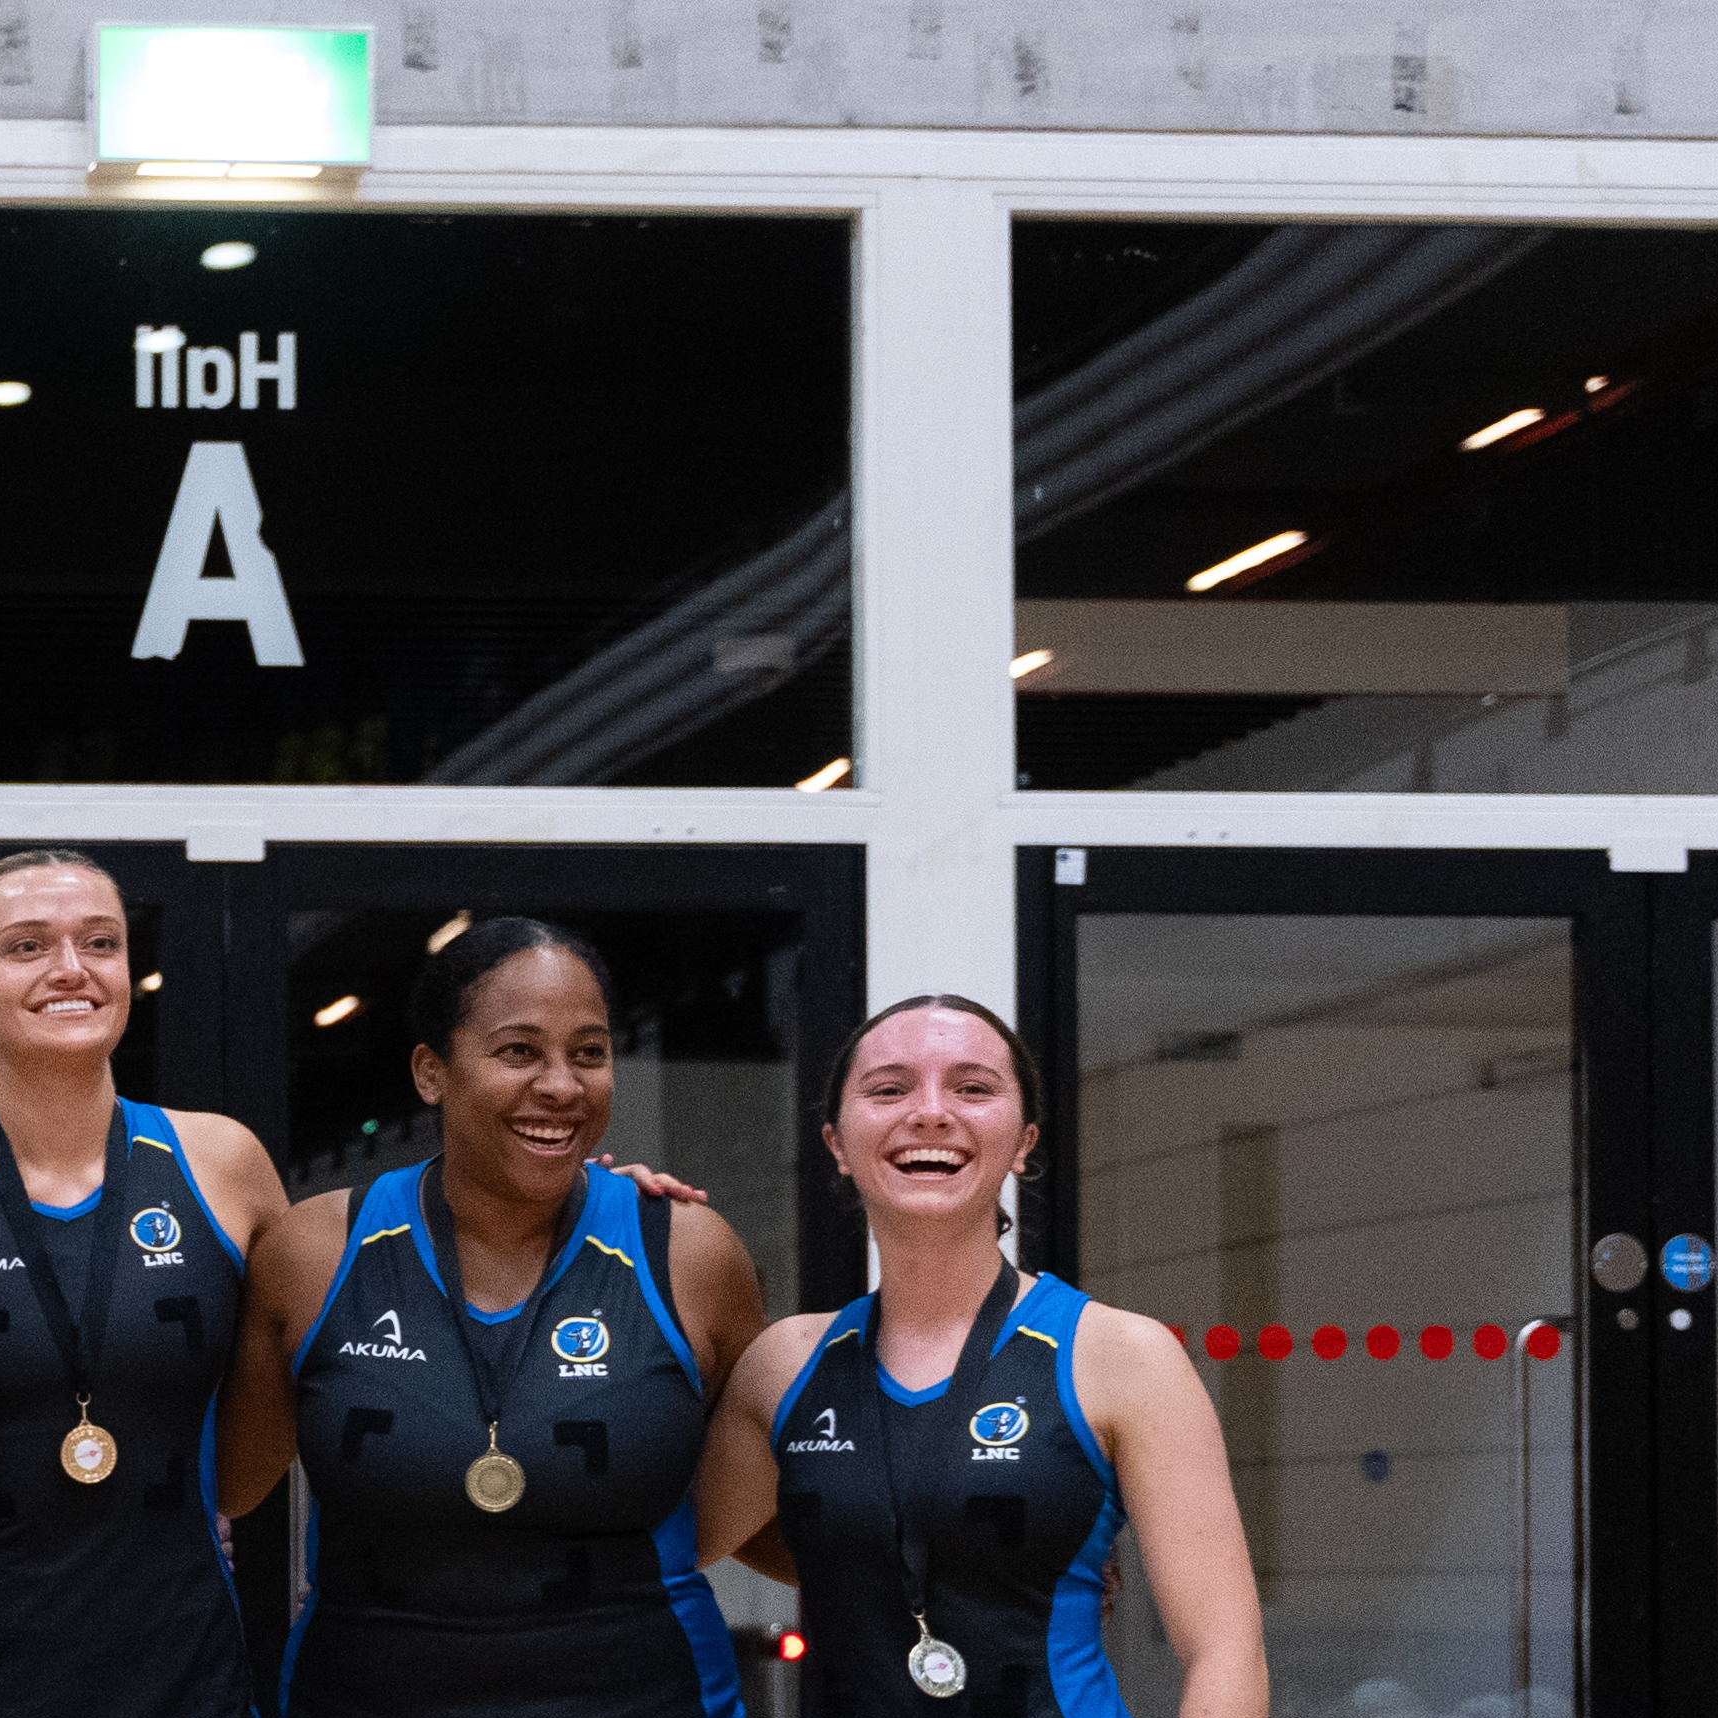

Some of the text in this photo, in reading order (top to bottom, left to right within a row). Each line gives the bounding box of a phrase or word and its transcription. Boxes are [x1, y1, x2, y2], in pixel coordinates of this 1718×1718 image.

[142, 1252, 184, 1267] LNC
[339, 1340, 427, 1362] AKUMA
[558, 1363, 609, 1378] LNC
[787, 1439, 856, 1453] AKUMA
[971, 1447, 1021, 1461] LNC
